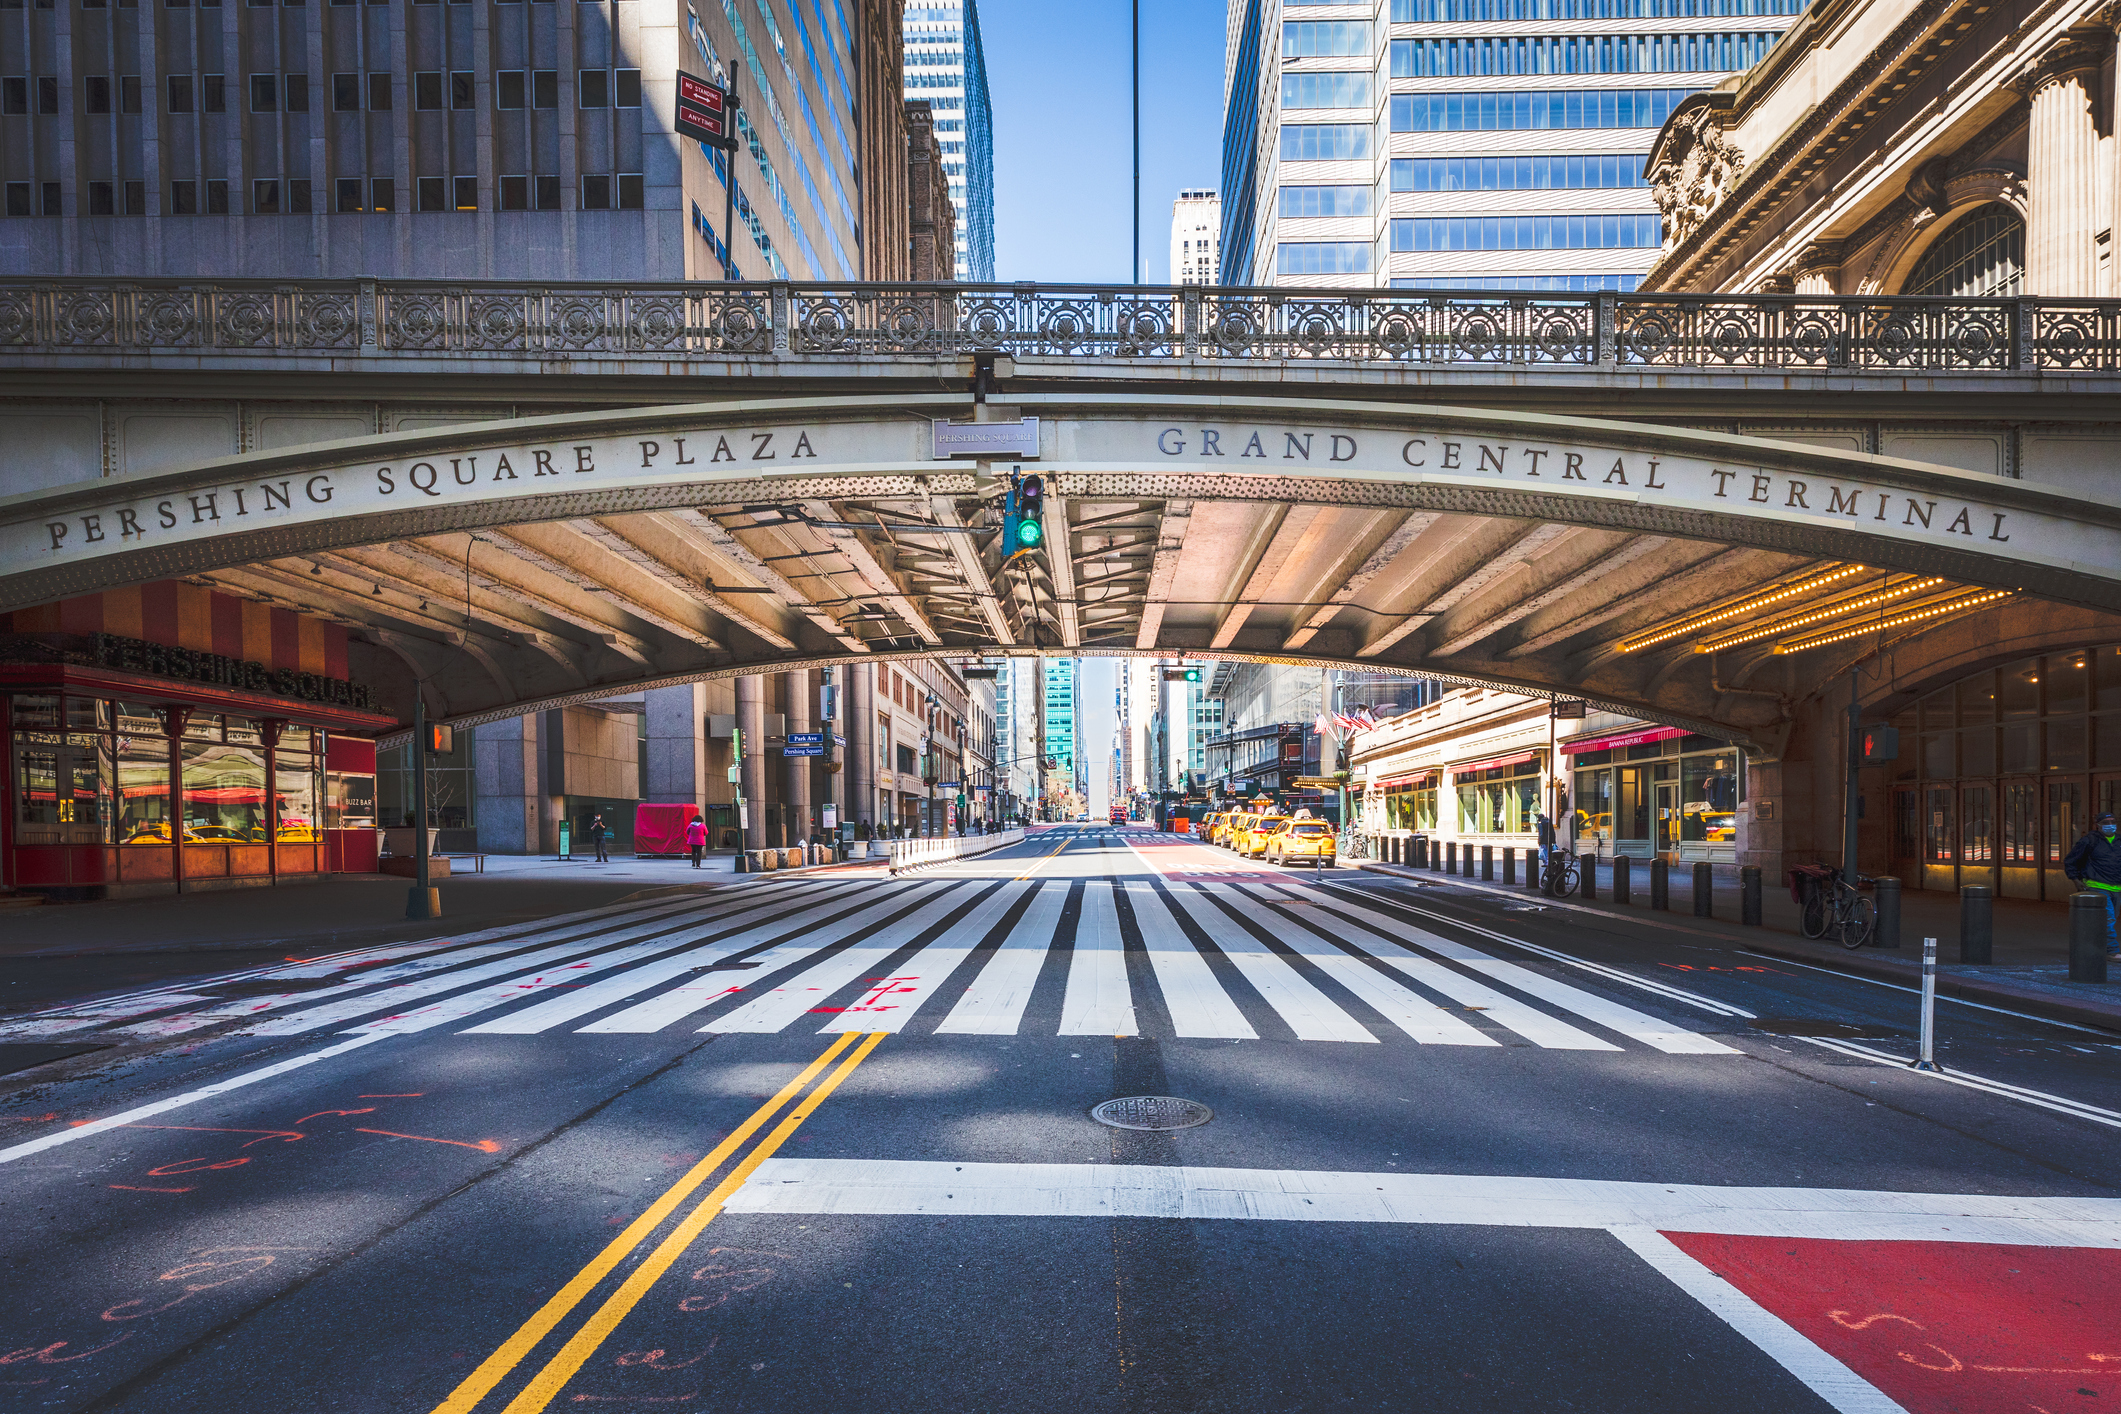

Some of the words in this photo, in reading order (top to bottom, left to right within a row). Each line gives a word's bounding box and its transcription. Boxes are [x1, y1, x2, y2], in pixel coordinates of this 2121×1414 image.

[685, 82, 693, 90] NO
[694, 85, 718, 100] STANDING
[688, 113, 714, 128] ANYTIME
[939, 434, 990, 444] PERSHING
[993, 433, 1033, 445] SQUARE
[45, 475, 334, 550] PERSHING
[377, 445, 595, 496] SQUARE
[638, 430, 817, 468] PLAZA
[1157, 427, 1357, 462] GRAND
[1402, 439, 1666, 489] CENTRAL
[1711, 468, 2010, 542] TERMINAL
[96, 632, 268, 691] PERSHING
[274, 667, 379, 709] SQUARE
[1608, 740, 1625, 748] BANANA
[1625, 736, 1644, 745] REPUBLIC
[345, 798, 359, 806] BUZZ
